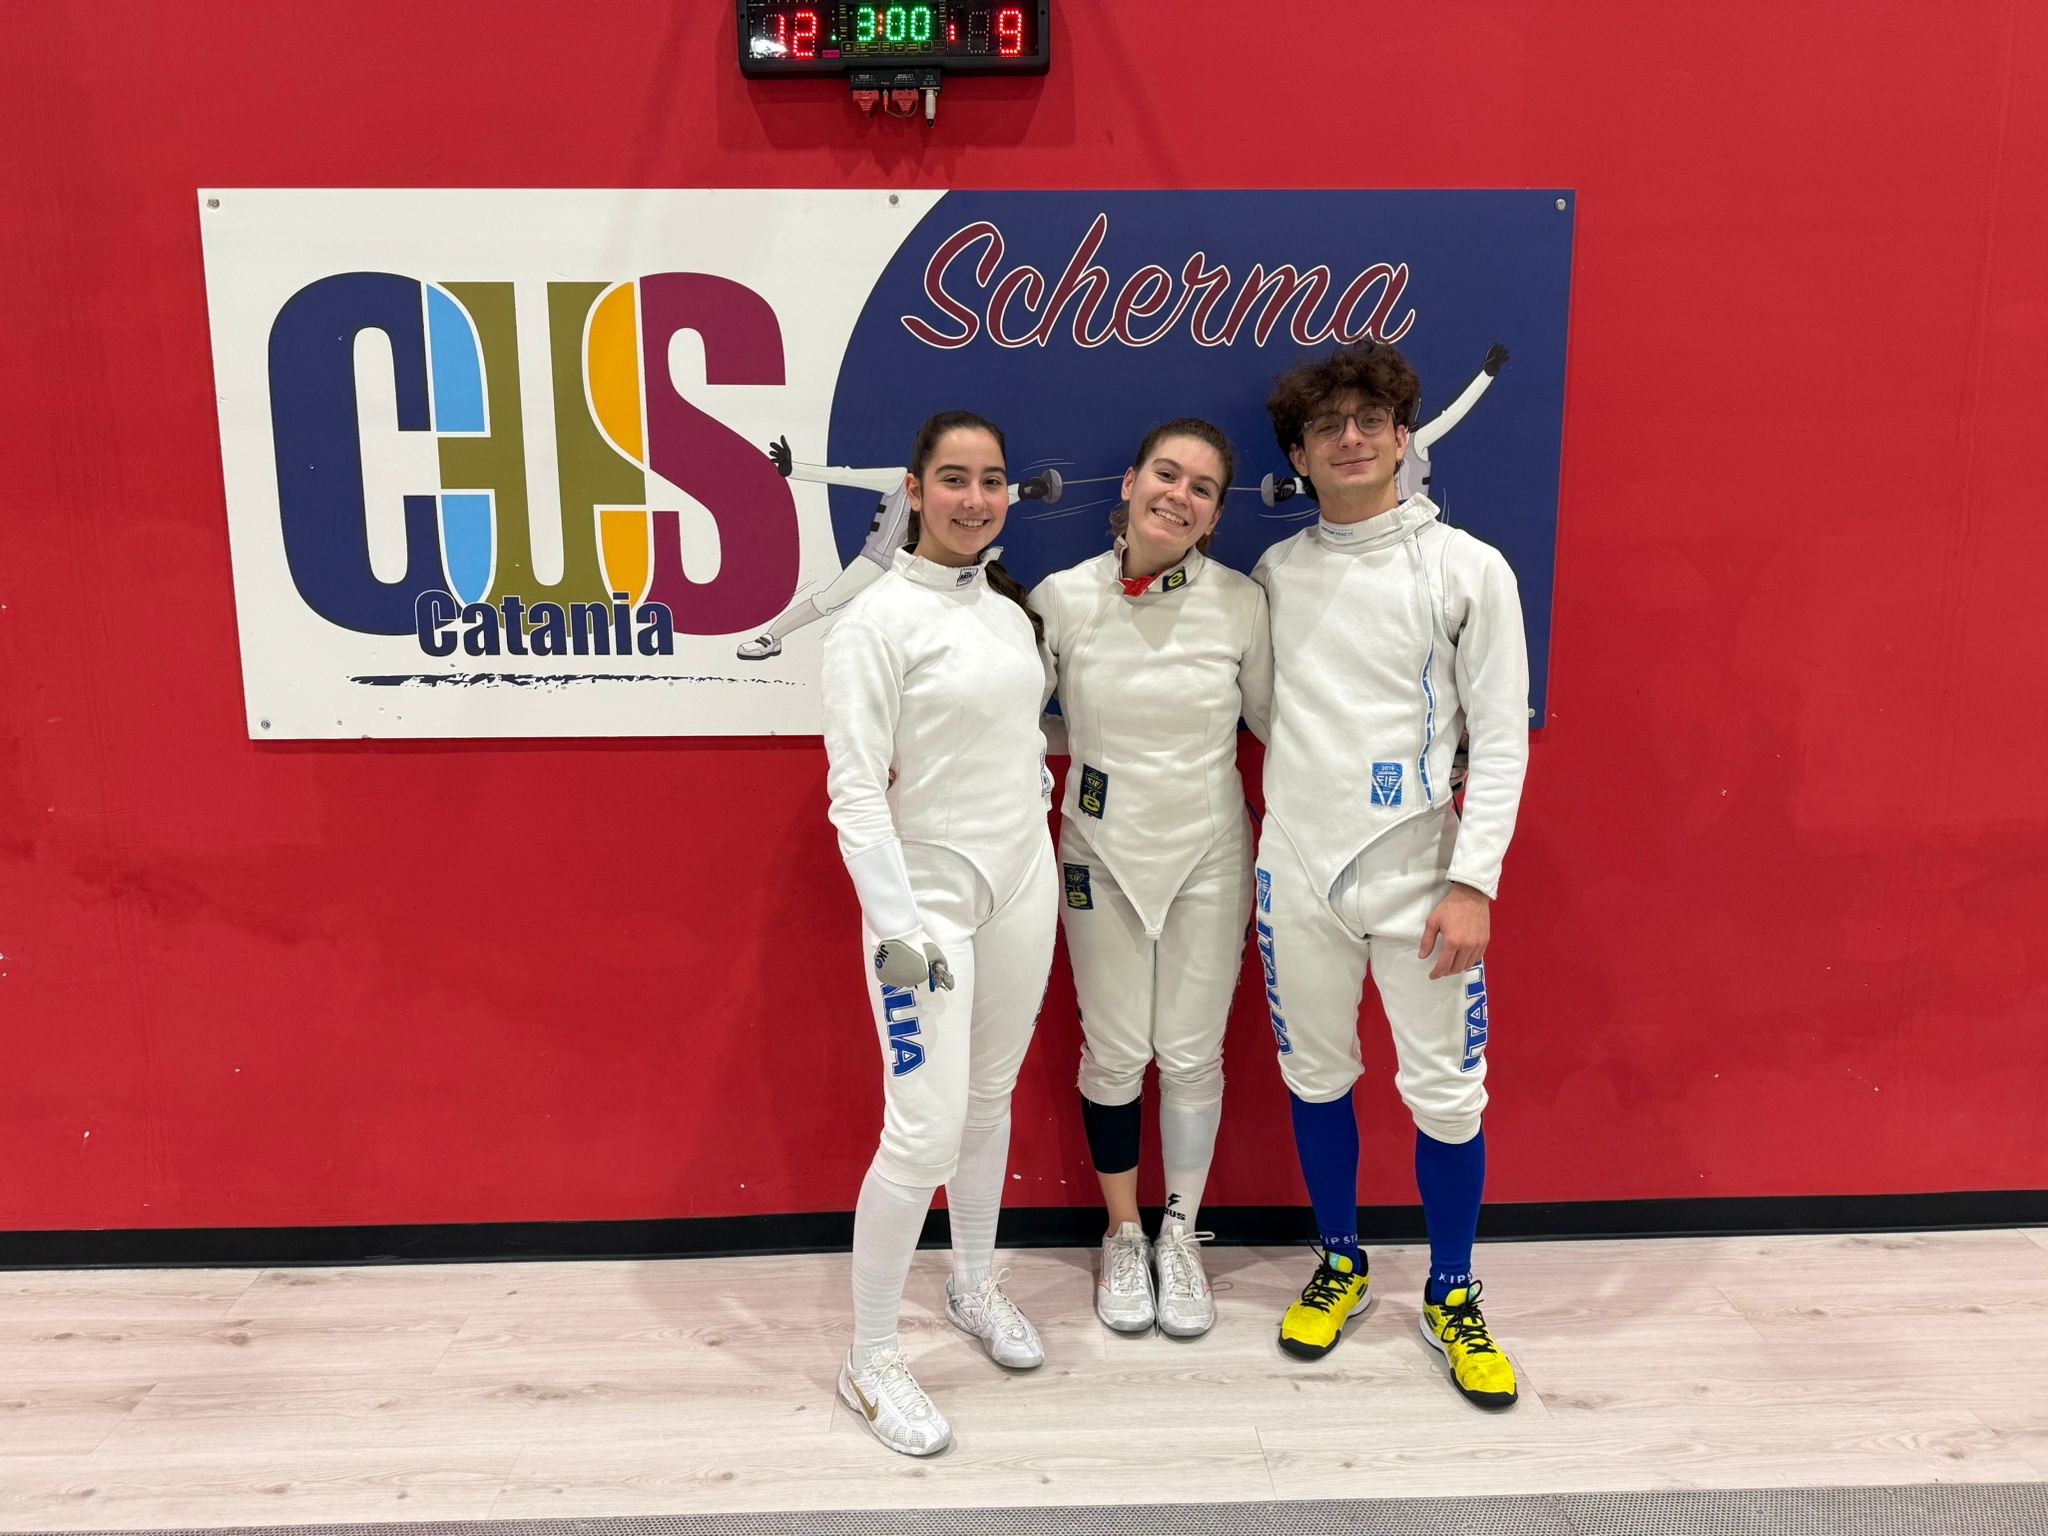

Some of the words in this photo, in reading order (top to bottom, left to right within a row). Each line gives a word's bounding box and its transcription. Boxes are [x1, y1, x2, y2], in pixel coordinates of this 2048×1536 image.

[857, 7, 931, 41] 3:00
[999, 9, 1022, 53] 9
[900, 213, 1417, 348] Scherma
[268, 271, 801, 636] CUS
[415, 589, 675, 657] Catania
